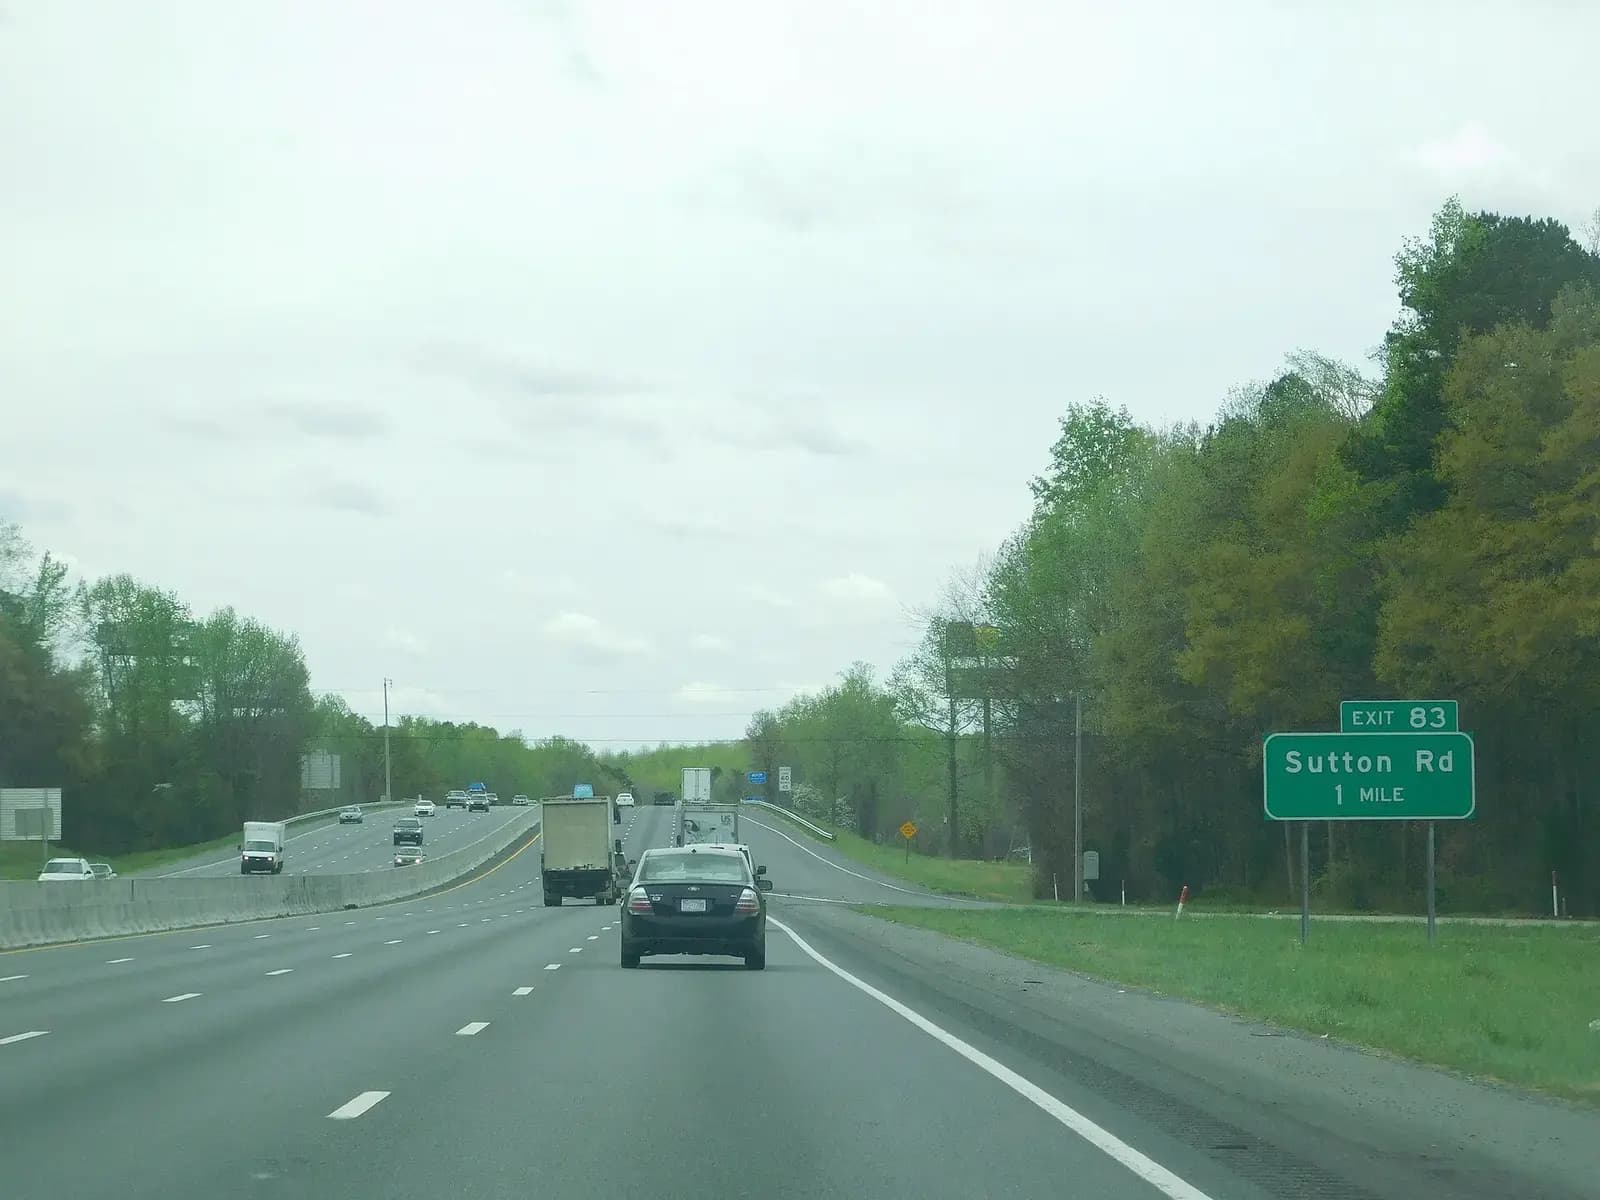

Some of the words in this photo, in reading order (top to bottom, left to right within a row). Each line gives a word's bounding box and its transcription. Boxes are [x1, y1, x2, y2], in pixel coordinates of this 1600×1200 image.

[1352, 711, 1395, 725] EXIT
[1409, 706, 1447, 728] 83
[1285, 750, 1392, 773] Sutton
[1416, 750, 1453, 773] Rd
[1334, 784, 1343, 805] 1
[1359, 787, 1405, 802] MILE
